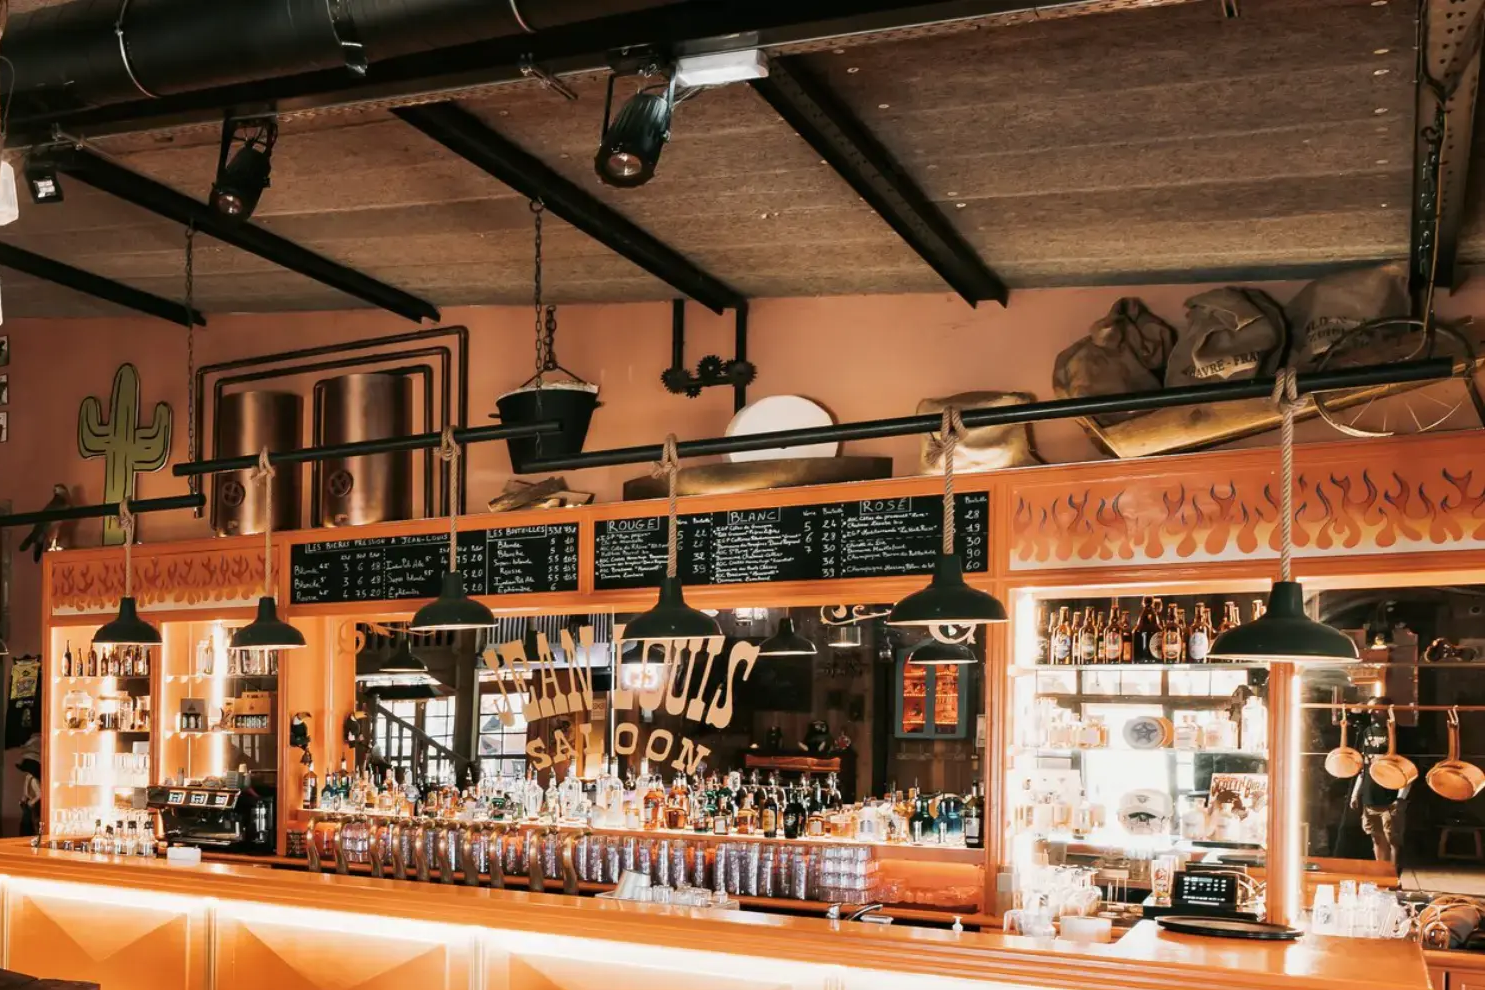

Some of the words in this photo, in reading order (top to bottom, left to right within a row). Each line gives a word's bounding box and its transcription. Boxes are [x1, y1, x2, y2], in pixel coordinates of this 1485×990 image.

[863, 497, 907, 512] ROSÉ
[731, 511, 776, 523] BLANC
[965, 510, 979, 519] 28
[609, 519, 655, 531] ROUGE
[804, 521, 811, 532] 5
[822, 520, 836, 528] 24
[489, 529, 502, 538] LES
[678, 531, 684, 540] 5
[805, 532, 813, 542] 6
[677, 542, 683, 550] 6
[967, 537, 980, 546] 30
[308, 543, 321, 551] LES
[804, 546, 812, 554] 7
[967, 549, 980, 559] 90
[822, 557, 834, 565] 36
[966, 561, 980, 570] 60
[343, 563, 349, 572] 3
[371, 562, 380, 570] 18
[693, 564, 706, 573] 39
[822, 569, 834, 577] 39
[343, 577, 349, 587] 3
[357, 576, 363, 584] 6
[483, 625, 594, 727] JEAN
[613, 624, 760, 729] LOUIS
[526, 722, 711, 776] SALOON
